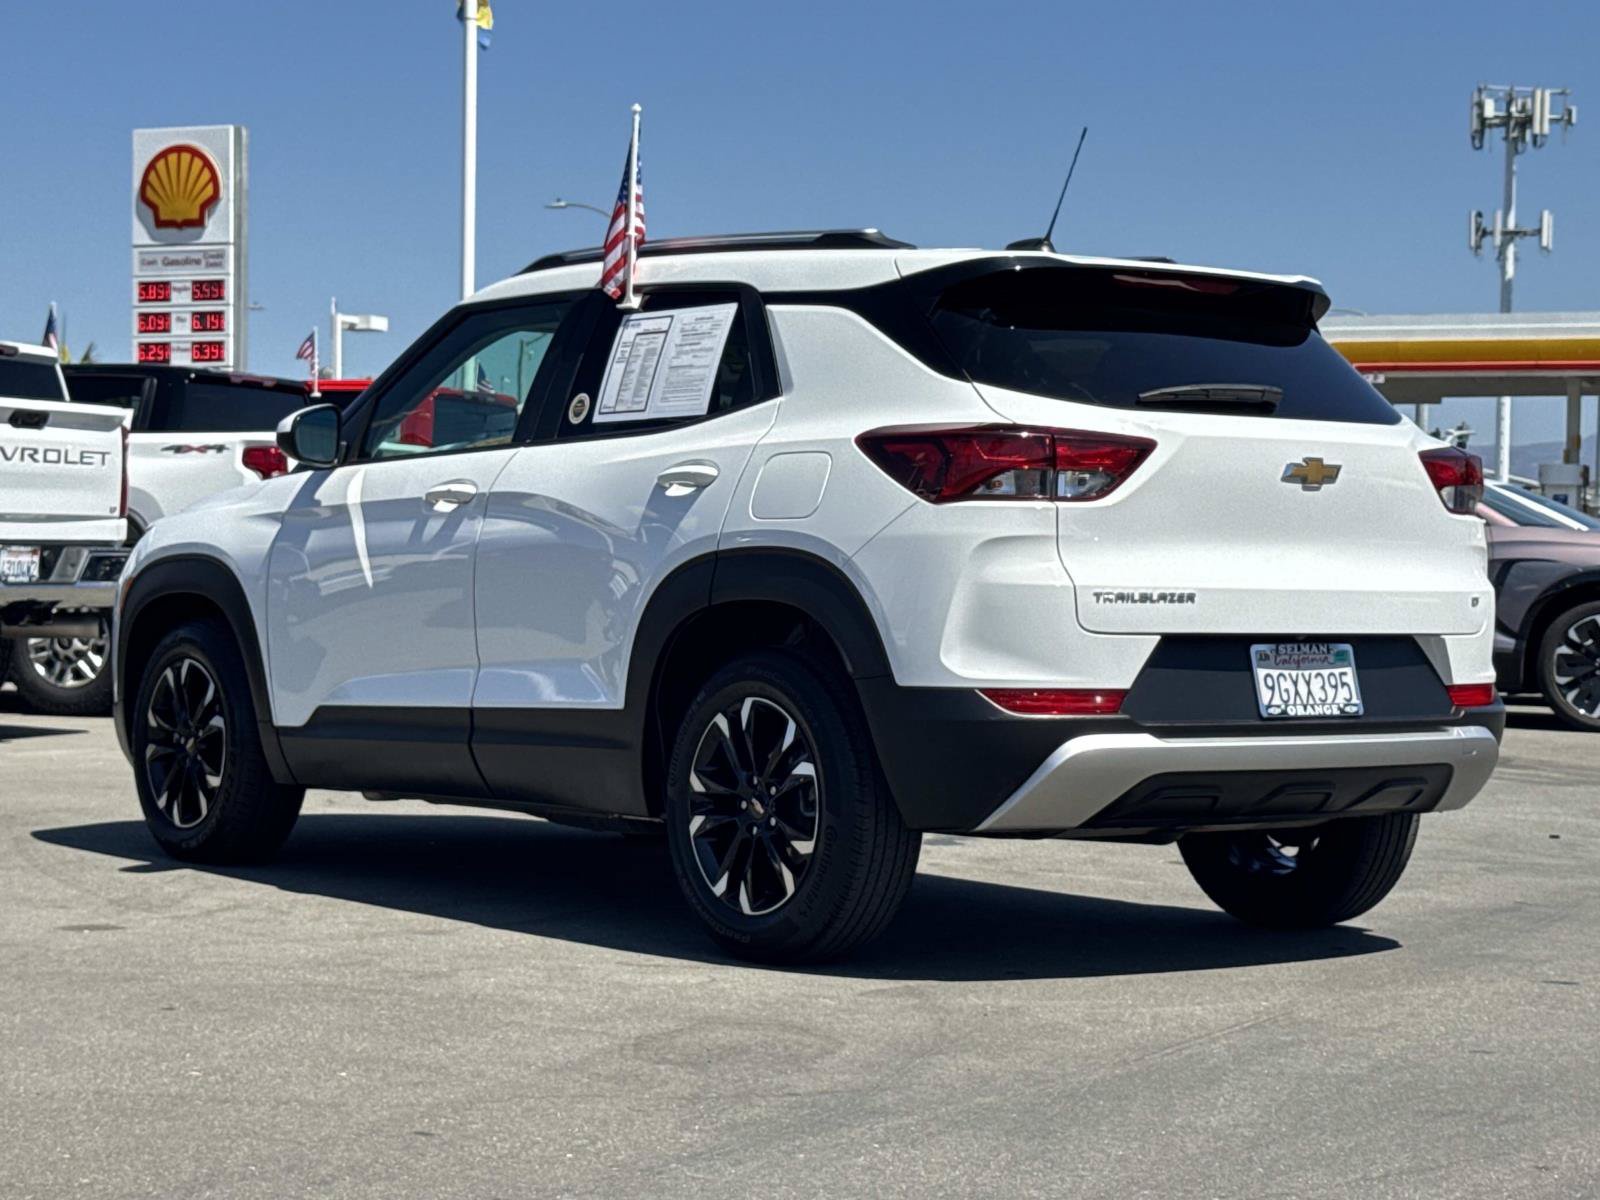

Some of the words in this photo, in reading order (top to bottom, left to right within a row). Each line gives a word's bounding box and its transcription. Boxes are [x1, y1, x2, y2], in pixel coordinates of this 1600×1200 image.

[162, 256, 202, 267] Gasoline
[0, 446, 110, 466] VROLET
[1093, 592, 1196, 604] TRAILBLAZER
[1279, 643, 1328, 654] SELMAN
[1274, 653, 1336, 667] California
[1264, 671, 1353, 706] 9GXX395
